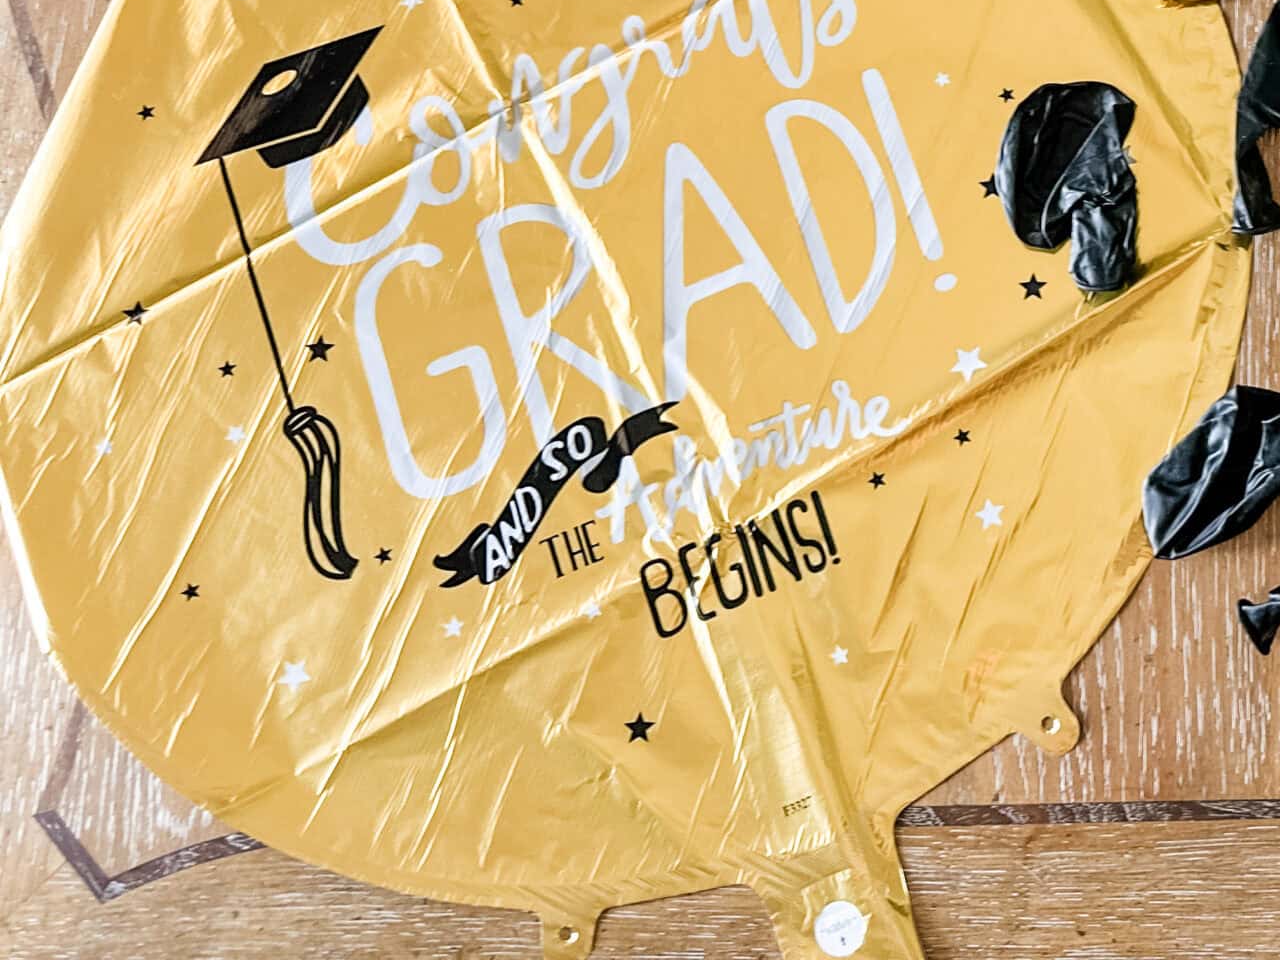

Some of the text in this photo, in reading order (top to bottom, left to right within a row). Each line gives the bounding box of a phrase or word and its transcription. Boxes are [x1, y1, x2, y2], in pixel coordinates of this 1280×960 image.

[354, 68, 959, 499] GRAD!
[483, 424, 593, 583] AND SO
[540, 380, 912, 579] THE Adventure
[640, 490, 843, 639] BEGINS!
